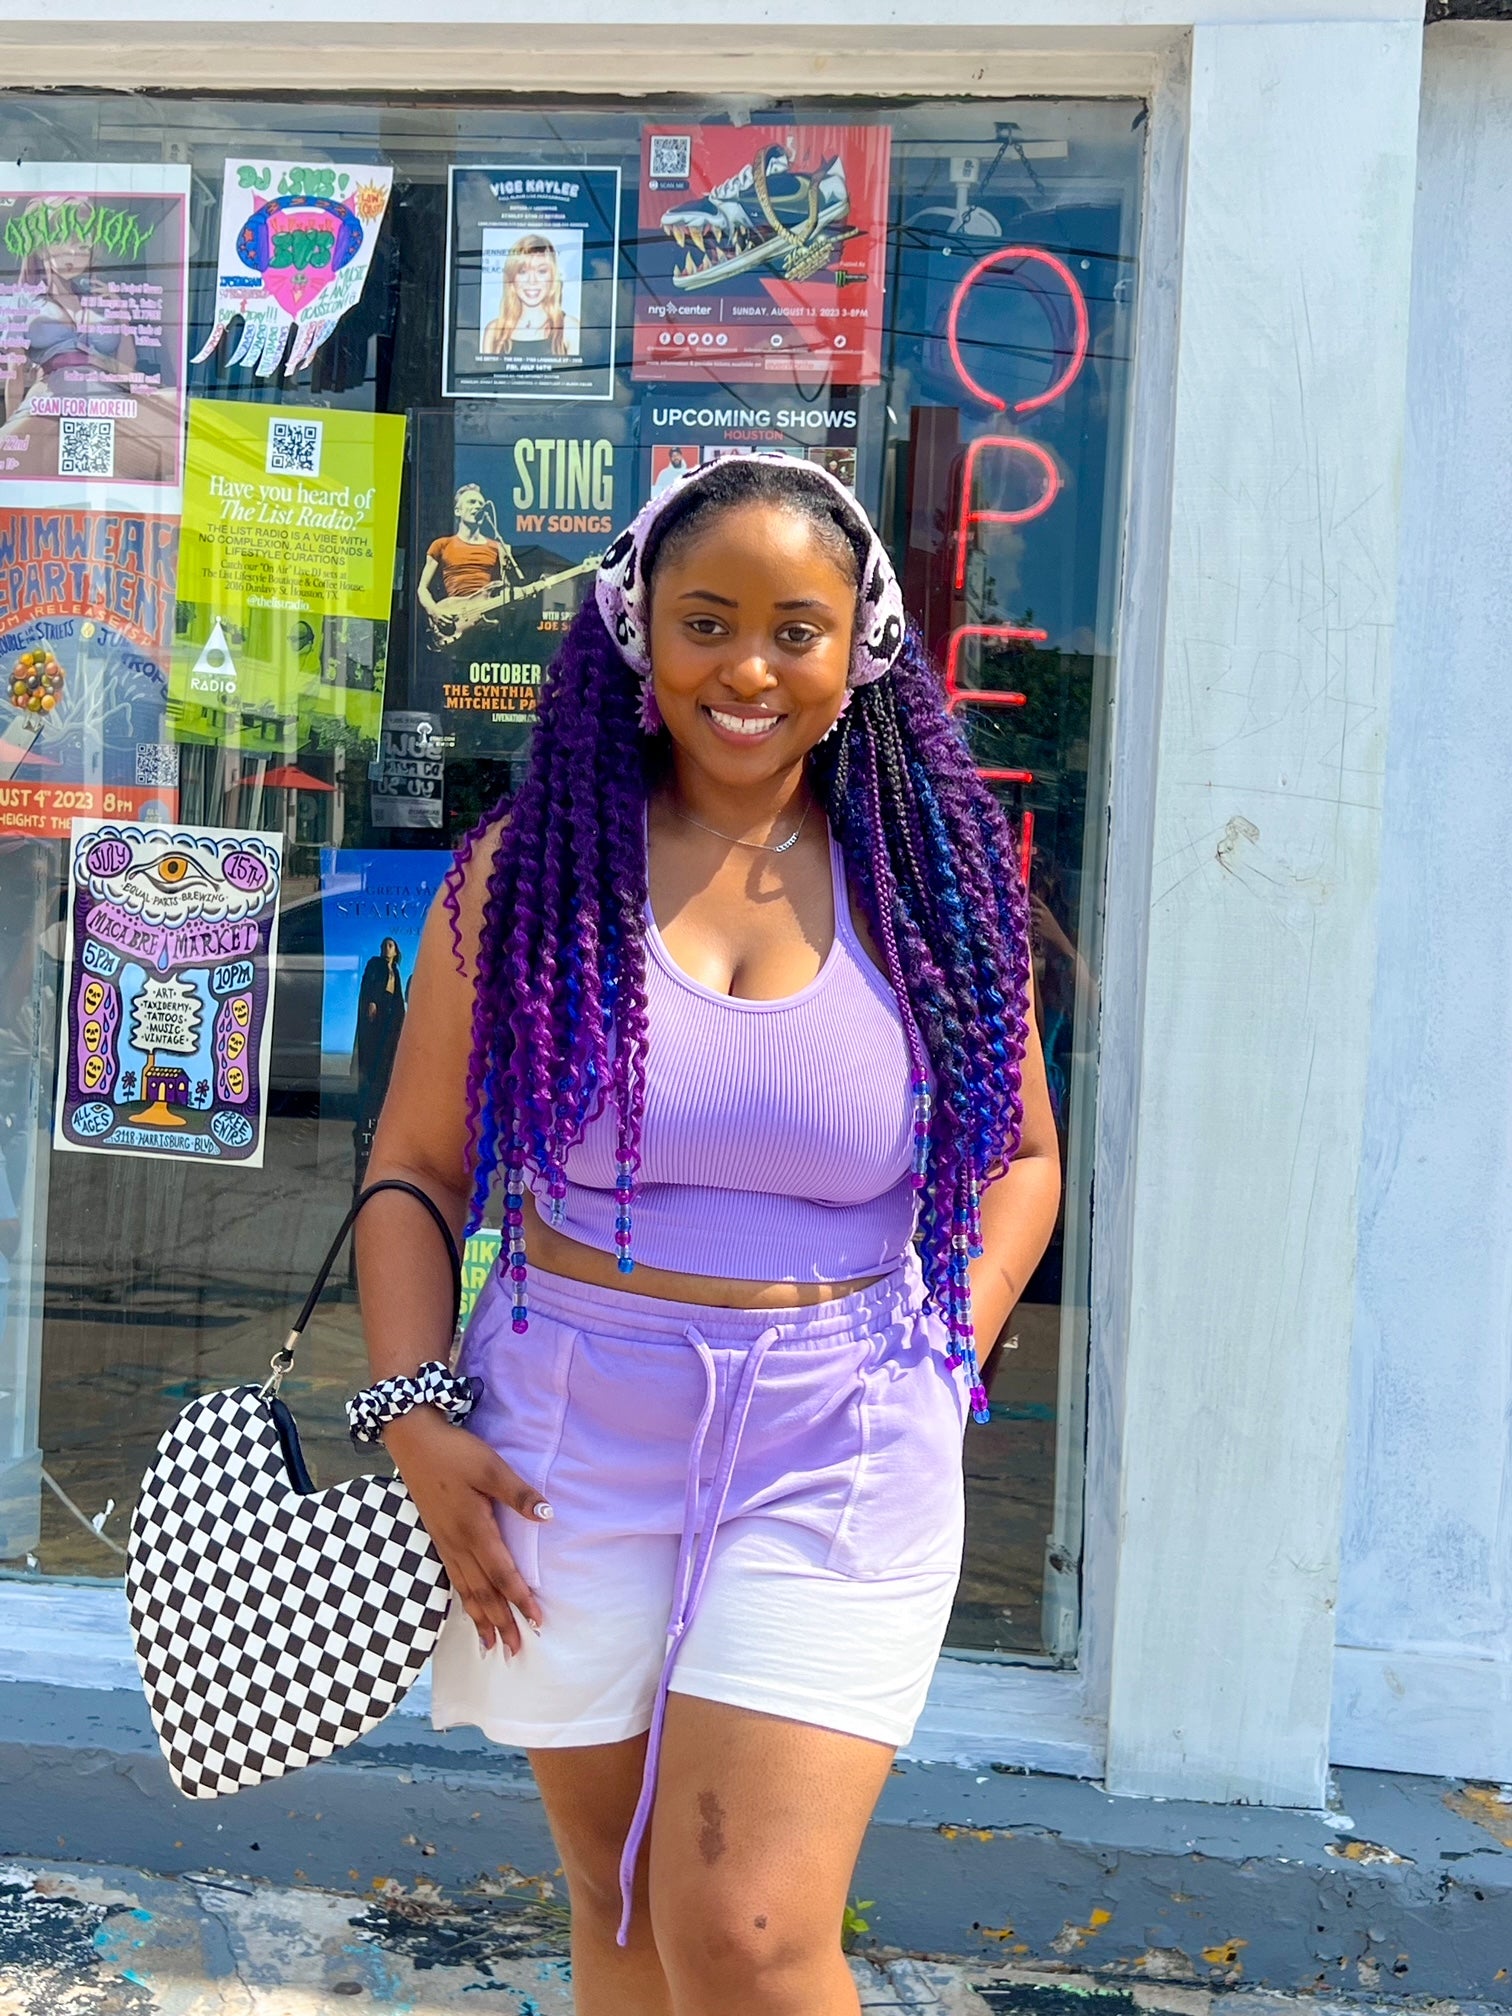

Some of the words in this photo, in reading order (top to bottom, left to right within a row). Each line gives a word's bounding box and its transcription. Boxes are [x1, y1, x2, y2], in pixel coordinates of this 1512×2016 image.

[236, 165, 271, 191] DJ
[490, 180, 523, 197] VICE
[525, 179, 580, 198] KAYLEE
[329, 281, 354, 299] ANY
[648, 305, 665, 317] nrg
[678, 306, 711, 316] center
[770, 307, 804, 317] AUGUST
[819, 307, 840, 317] 2023
[30, 399, 60, 415] SCAN
[64, 399, 86, 416] FOR
[652, 408, 771, 427] UPCOMING
[776, 410, 857, 428] SHOWS
[724, 430, 784, 441] HOUSTON
[513, 438, 613, 511] STING
[209, 475, 254, 499] Have
[258, 485, 293, 505] you
[297, 484, 349, 506] heard
[354, 488, 373, 508] of
[219, 499, 252, 522] The
[256, 503, 293, 525] List
[297, 507, 363, 531] Radio?
[516, 514, 547, 533] MY
[547, 515, 612, 534] SONGS
[207, 524, 228, 534] THE
[230, 525, 253, 535] LIST
[256, 527, 289, 539] RADIO
[290, 530, 300, 540] IS
[303, 531, 311, 541] A
[313, 532, 338, 543] VIBE
[340, 535, 368, 546] WITH
[199, 533, 215, 543] NO
[294, 542, 315, 552] ALL
[318, 544, 363, 556] SOUNDS
[365, 548, 374, 558] &
[225, 547, 281, 560] LIFESTYLE
[283, 552, 345, 565] CURATIONS
[220, 560, 243, 570] Catch
[244, 563, 258, 571] our
[312, 568, 321, 578] DJ
[946, 246, 1089, 896] OPE
[202, 568, 218, 577] The
[218, 569, 233, 579] List
[234, 571, 266, 584] Lifestyle
[268, 576, 303, 588] Boutique
[304, 577, 311, 586] &
[312, 578, 338, 590] Coffee
[224, 582, 244, 591] 2016
[245, 583, 277, 596] Dunlavy
[35, 604, 121, 628] RELEASE
[542, 611, 560, 620] WITH
[536, 621, 559, 631] JOE
[469, 662, 542, 685] OCTOBER
[191, 678, 236, 693] RADIO
[443, 684, 470, 697] THE
[473, 685, 535, 698] CYNTHIA
[444, 697, 516, 710] MITCHELL
[52, 790, 94, 810] 2023
[91, 843, 126, 873] JULY
[227, 855, 263, 887] 15TH
[122, 882, 150, 903] EQUAL
[152, 897, 179, 906] PARTS
[181, 890, 226, 902] BREWING
[88, 911, 159, 956] MACABRE
[173, 924, 257, 959] MARKET
[84, 947, 115, 973] 5PM
[215, 965, 251, 989] 10PM
[155, 988, 174, 998] ART
[143, 1000, 190, 1011] TAXIDERMY
[146, 1012, 184, 1024] TATTOOS
[144, 1033, 185, 1044] VINTAGE
[149, 1024, 181, 1034] MUSIC
[74, 1109, 91, 1124] ALL
[82, 1112, 110, 1133] AGES
[221, 1111, 248, 1131] FREE
[114, 1130, 135, 1144] 3118
[138, 1132, 190, 1148] HARRISBURG
[213, 1120, 248, 1145] ENTRY
